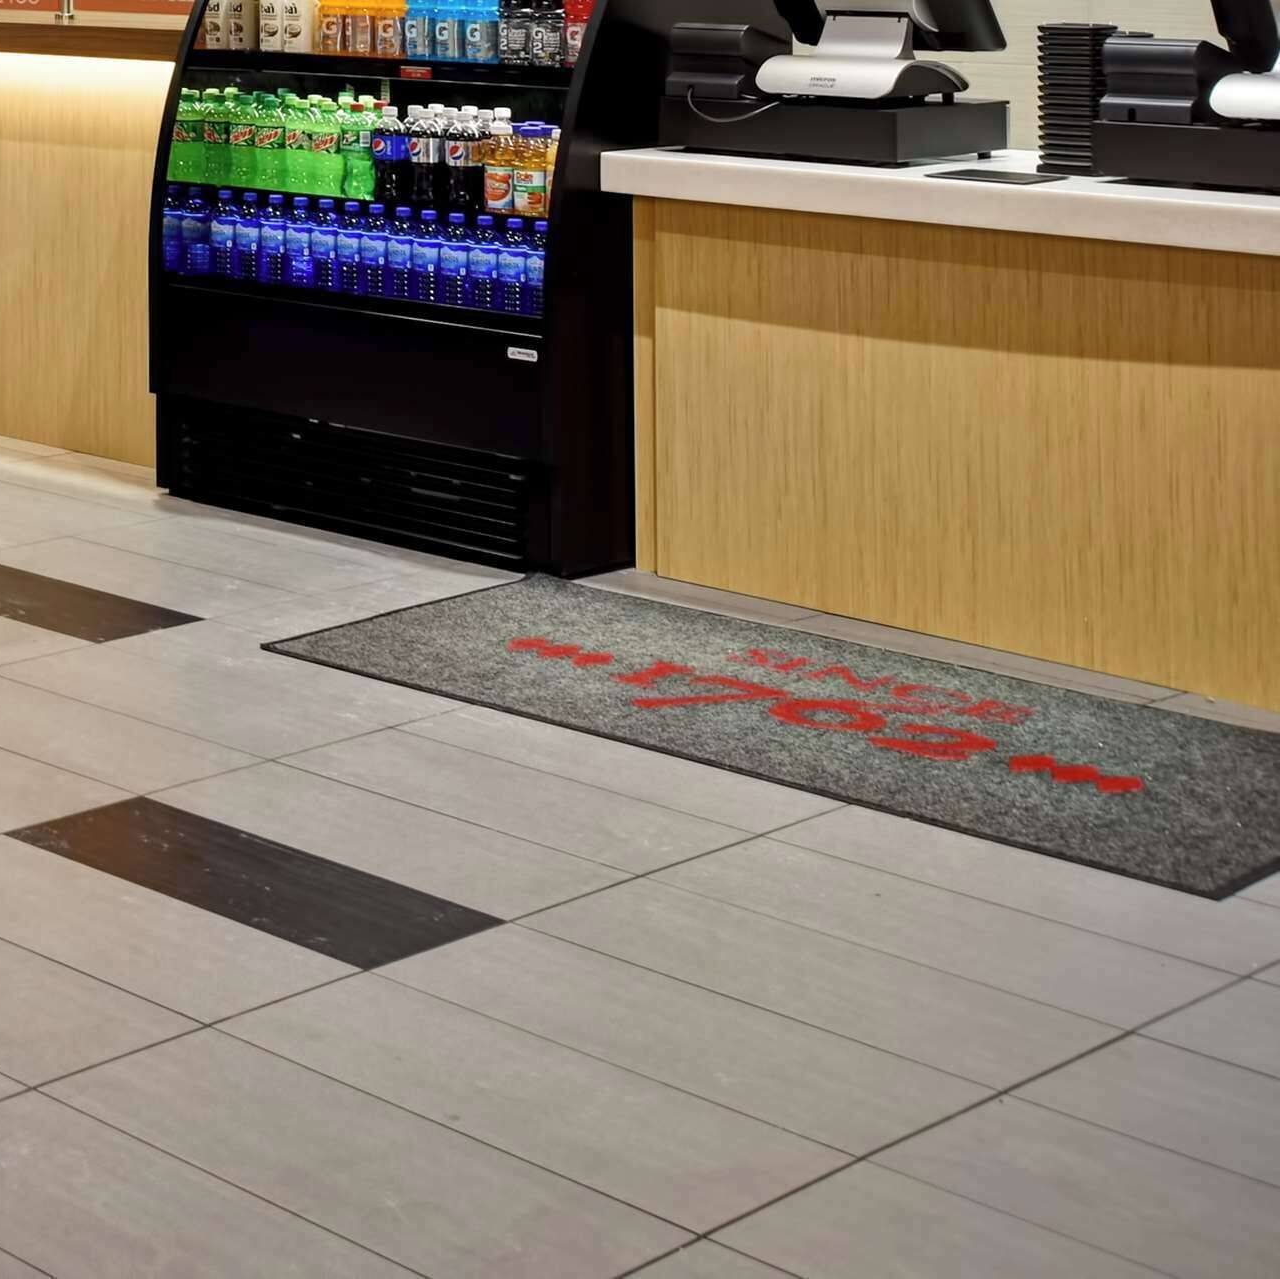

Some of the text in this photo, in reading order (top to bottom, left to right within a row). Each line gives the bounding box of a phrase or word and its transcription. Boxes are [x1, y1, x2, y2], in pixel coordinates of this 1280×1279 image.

[405, 21, 481, 42] G G G
[611, 661, 997, 761] 1762
[727, 648, 1039, 724] SINCE
